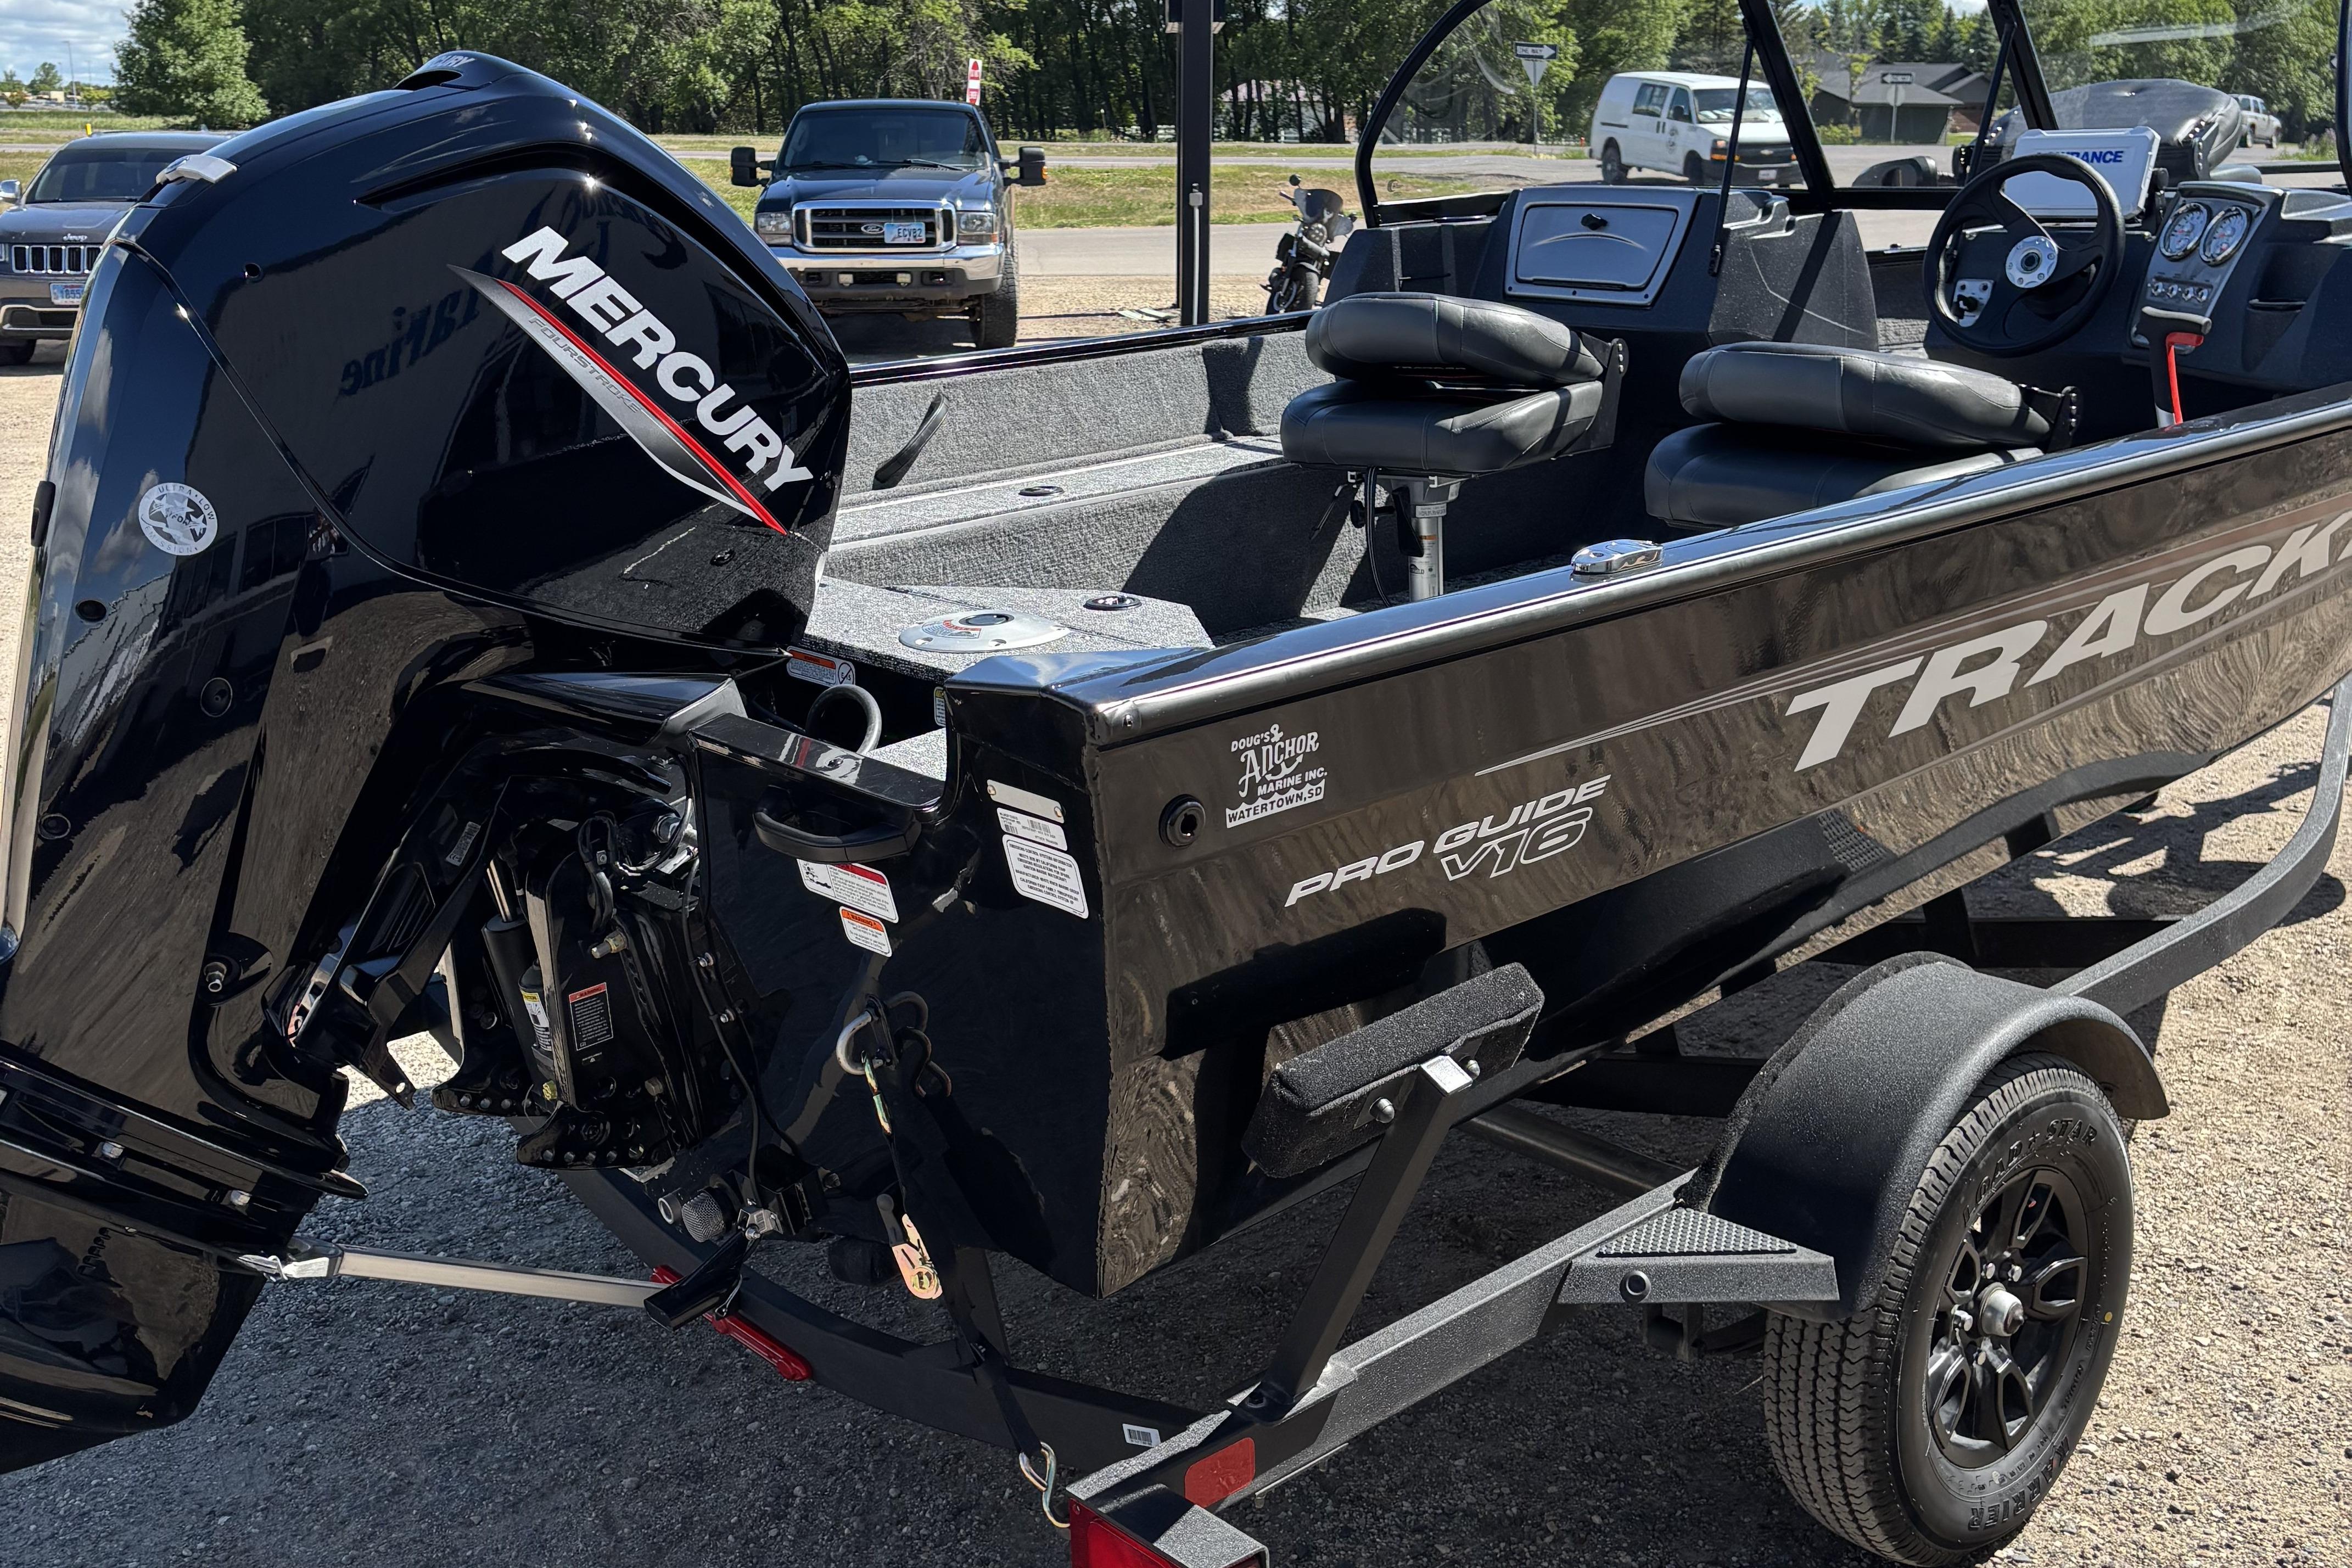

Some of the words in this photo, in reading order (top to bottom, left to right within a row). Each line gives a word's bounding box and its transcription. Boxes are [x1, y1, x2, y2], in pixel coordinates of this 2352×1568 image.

[63, 233, 88, 242] Jeep
[502, 226, 814, 491] MERCURY
[528, 316, 642, 413] FOURSTROKE
[1785, 511, 2352, 772] TRACK
[1231, 731, 1270, 752] DOUG'S
[1238, 731, 1319, 798] ANCHOR
[1257, 774, 1302, 796] MARINE
[1304, 766, 1328, 782] INC.
[1284, 841, 1425, 907] PRO
[1433, 775, 1611, 853] GUIDE
[1441, 806, 1593, 881] V16
[1963, 1140, 2023, 1228] LOAD
[2045, 1118, 2097, 1146] STAR
[1968, 1435, 2070, 1531] KARRIER
